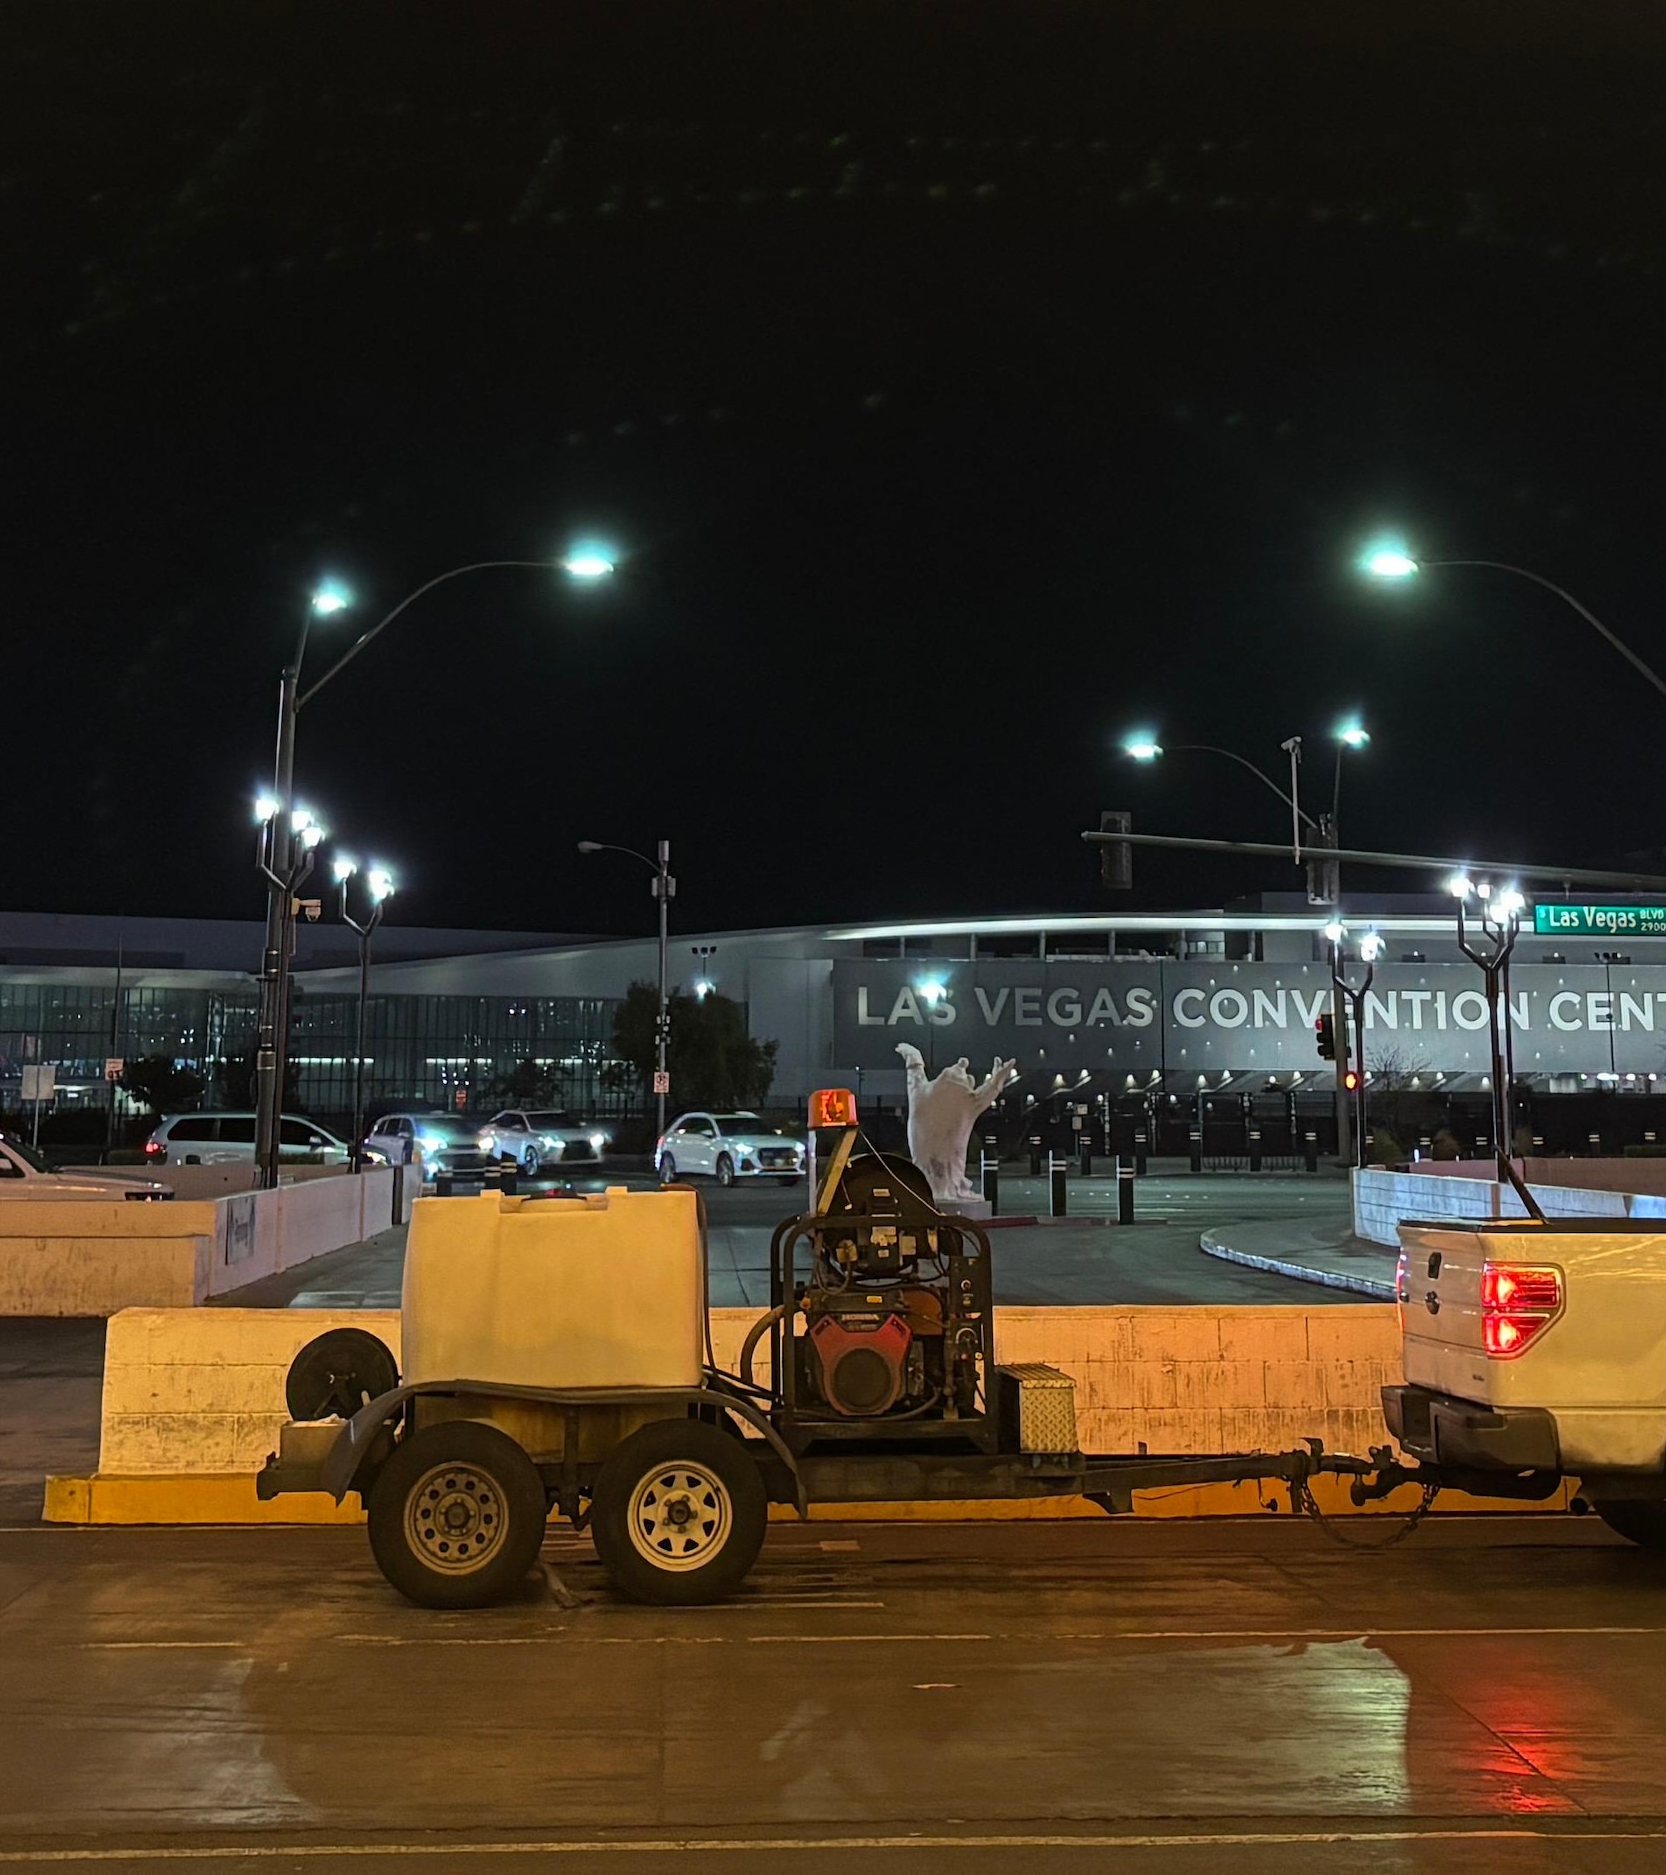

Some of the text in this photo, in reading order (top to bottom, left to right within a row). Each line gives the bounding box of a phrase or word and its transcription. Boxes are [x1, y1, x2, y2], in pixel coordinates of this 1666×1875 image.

[1549, 906, 1580, 927] Las
[1583, 906, 1637, 933] Vegas
[1639, 909, 1664, 920] BLVD
[1640, 922, 1666, 932] 2900
[858, 986, 957, 1026] LAS
[974, 986, 1155, 1027] VEGAS
